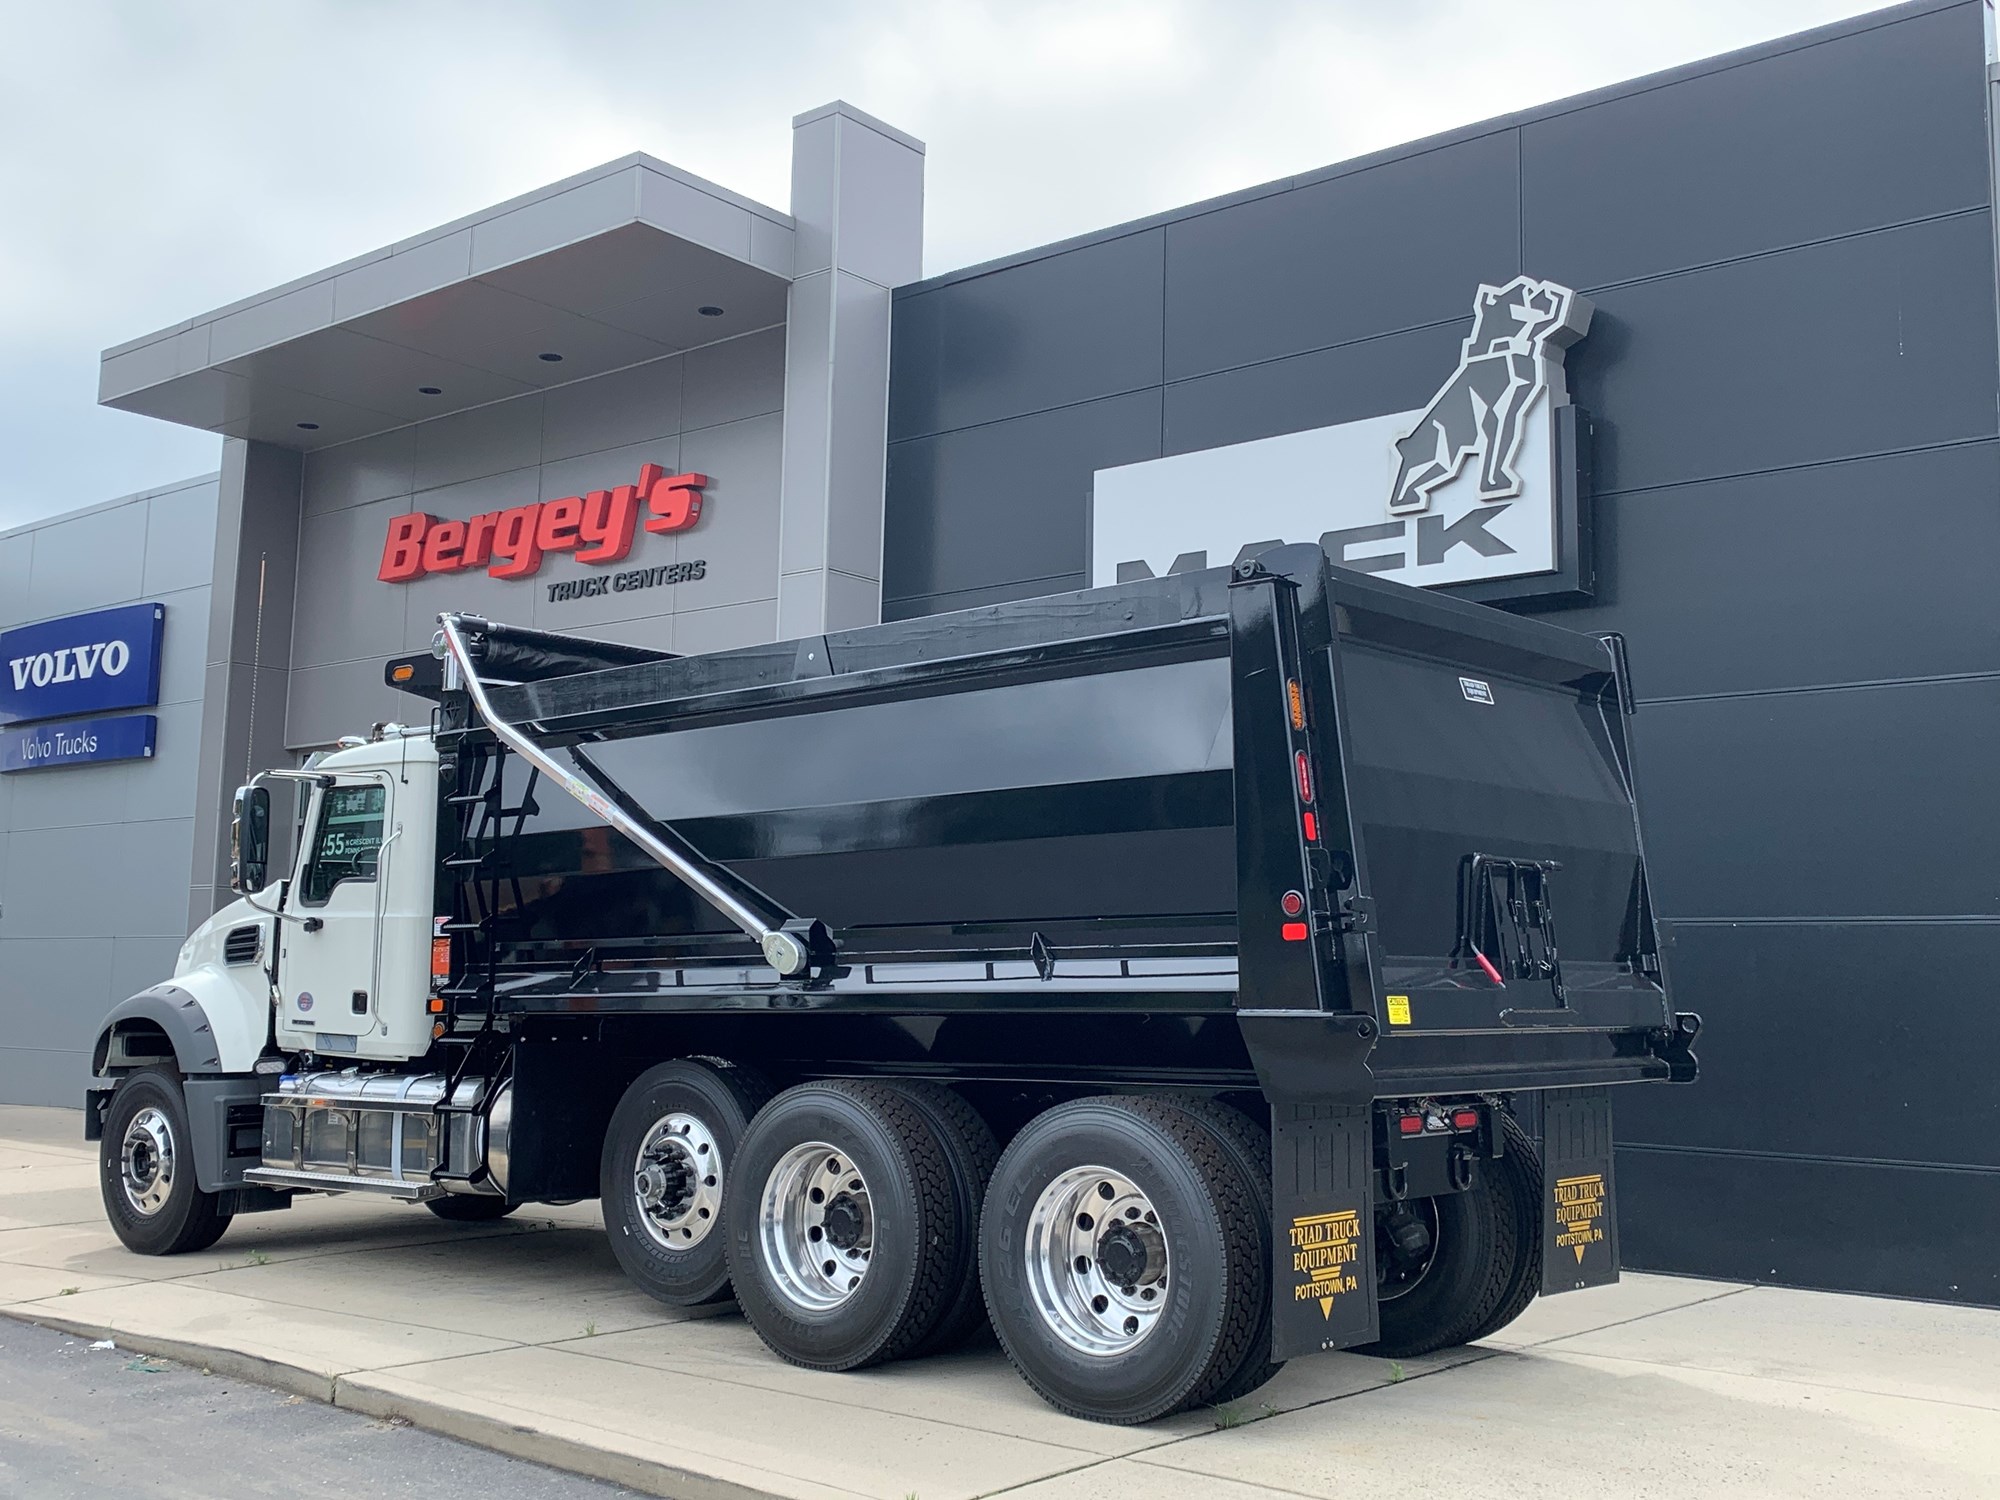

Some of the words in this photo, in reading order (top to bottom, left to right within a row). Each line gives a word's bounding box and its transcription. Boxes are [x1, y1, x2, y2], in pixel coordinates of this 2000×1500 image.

[377, 463, 707, 583] Bergey's
[1116, 503, 1518, 584] MCK
[547, 574, 608, 602] TRUCK
[612, 559, 707, 592] CENTERS
[9, 640, 129, 691] VOLVO
[22, 736, 51, 760] Volvo
[55, 731, 97, 755] Trucks
[1554, 1186, 1577, 1203] TRIAD
[1579, 1181, 1605, 1199] TRUCK
[1556, 1202, 1602, 1225] EQUIPMENT
[1289, 1225, 1322, 1246] TRIAD
[1325, 1219, 1360, 1240] TRUCK
[1556, 1230, 1594, 1248] POTTSTOWN,
[1594, 1228, 1603, 1241] PA
[1293, 1243, 1357, 1272] EQUIPMENT
[1295, 1278, 1345, 1301] POTTSTOWN,
[1346, 1276, 1357, 1291] PA
